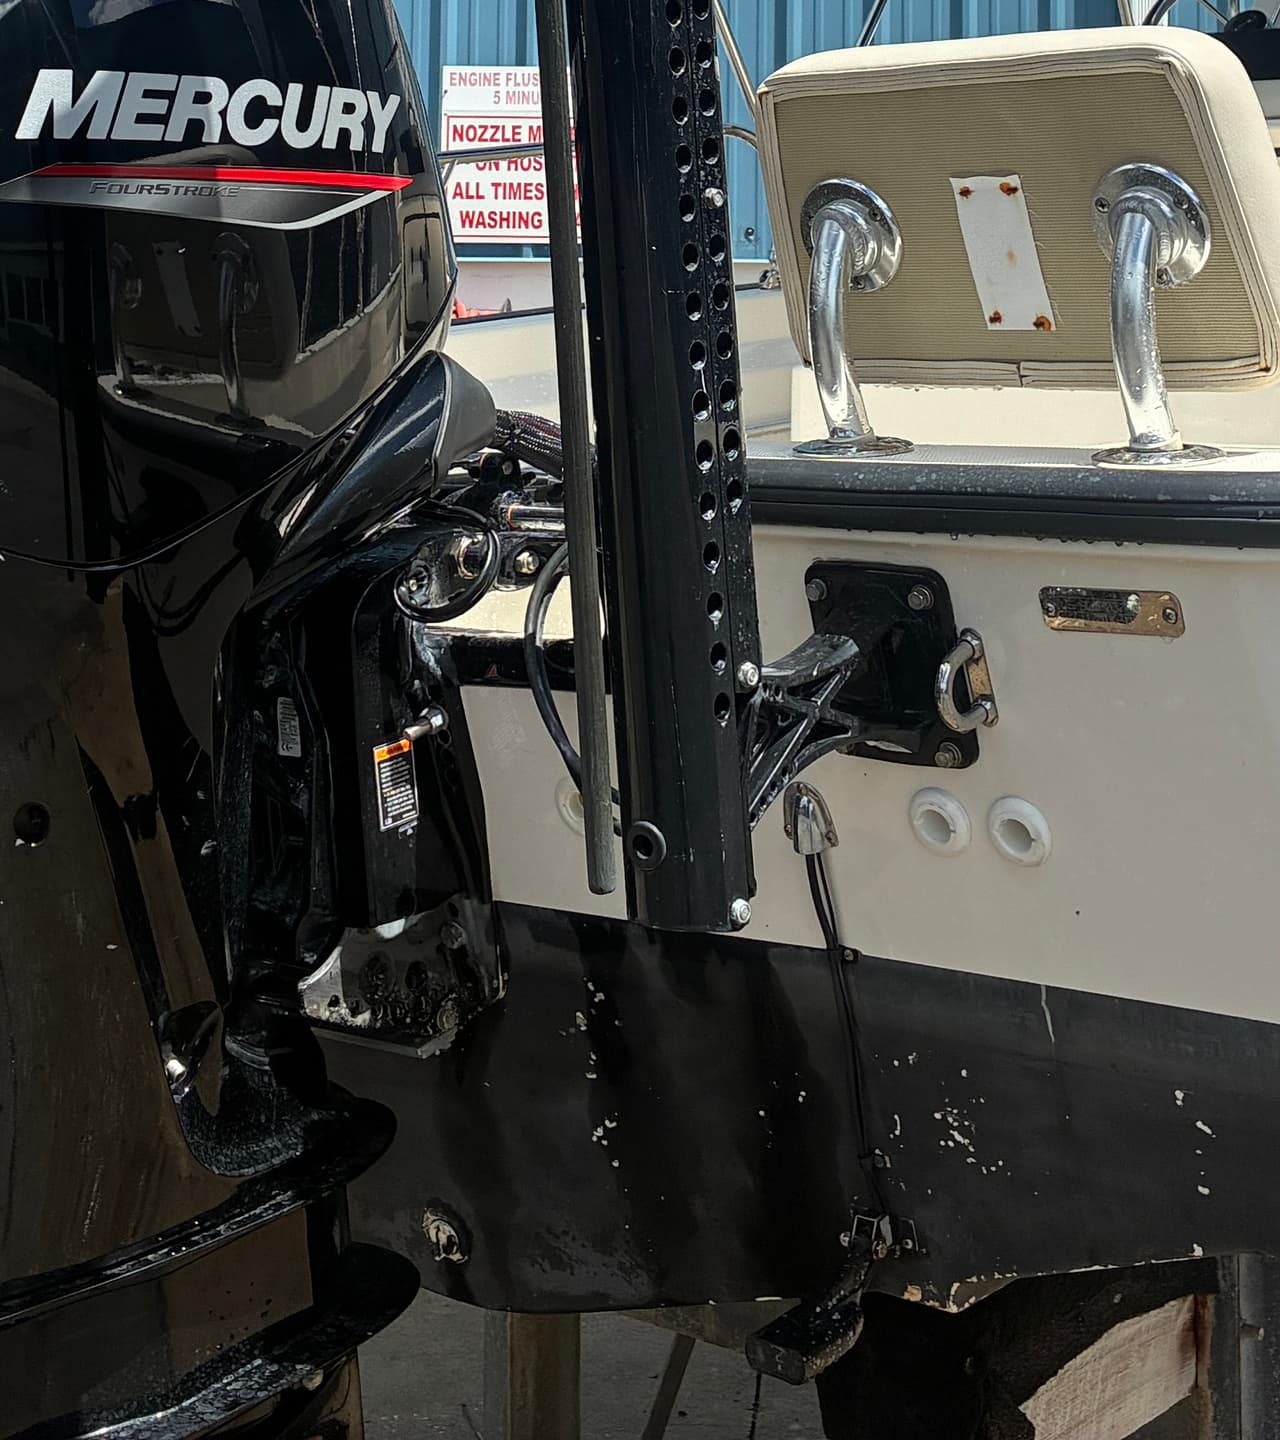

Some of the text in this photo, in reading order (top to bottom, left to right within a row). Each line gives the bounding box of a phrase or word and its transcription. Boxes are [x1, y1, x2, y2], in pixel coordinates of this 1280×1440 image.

[449, 72, 540, 87] ENGINE FLUS
[493, 91, 540, 105] 5 MINU
[14, 68, 401, 154] MERCURY
[452, 124, 522, 143] NOZZLE
[507, 157, 543, 171] HOS
[452, 181, 545, 201] ALL TIMES
[459, 210, 543, 229] WASHING
